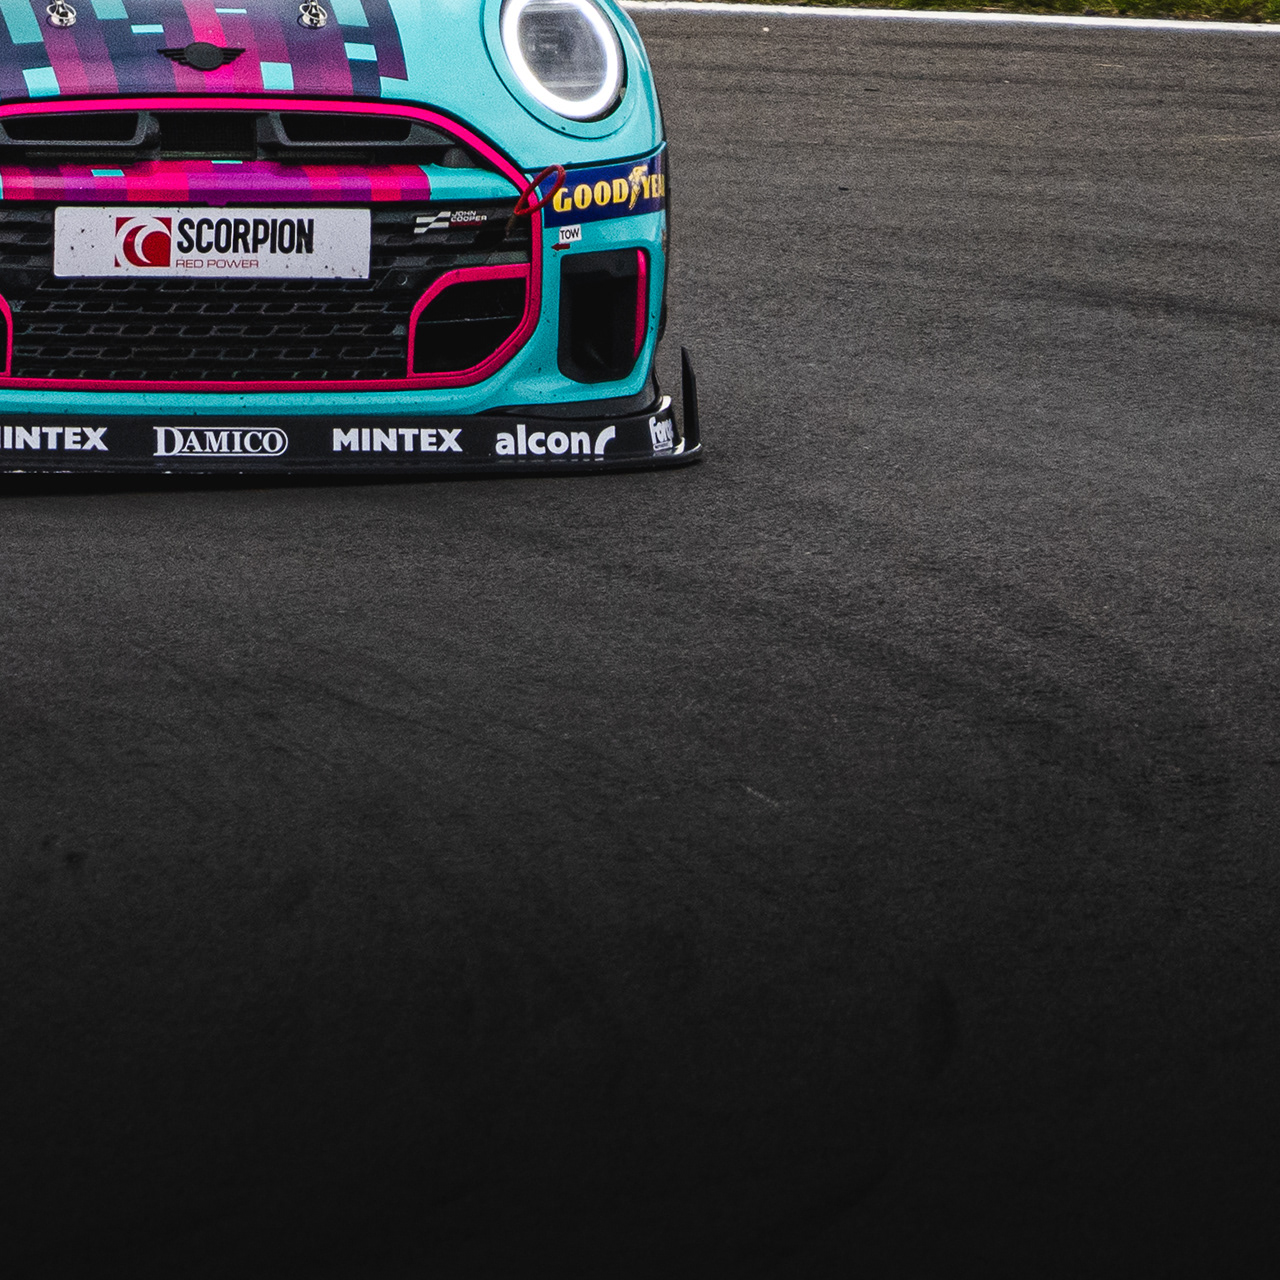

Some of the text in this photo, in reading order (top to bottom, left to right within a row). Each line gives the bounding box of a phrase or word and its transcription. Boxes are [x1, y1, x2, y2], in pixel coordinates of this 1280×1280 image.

[176, 217, 315, 254] SCORPION
[560, 227, 580, 240] TOW
[176, 259, 259, 269] RED POWER
[153, 426, 286, 456] DAMICO
[333, 427, 463, 452] MINTEX
